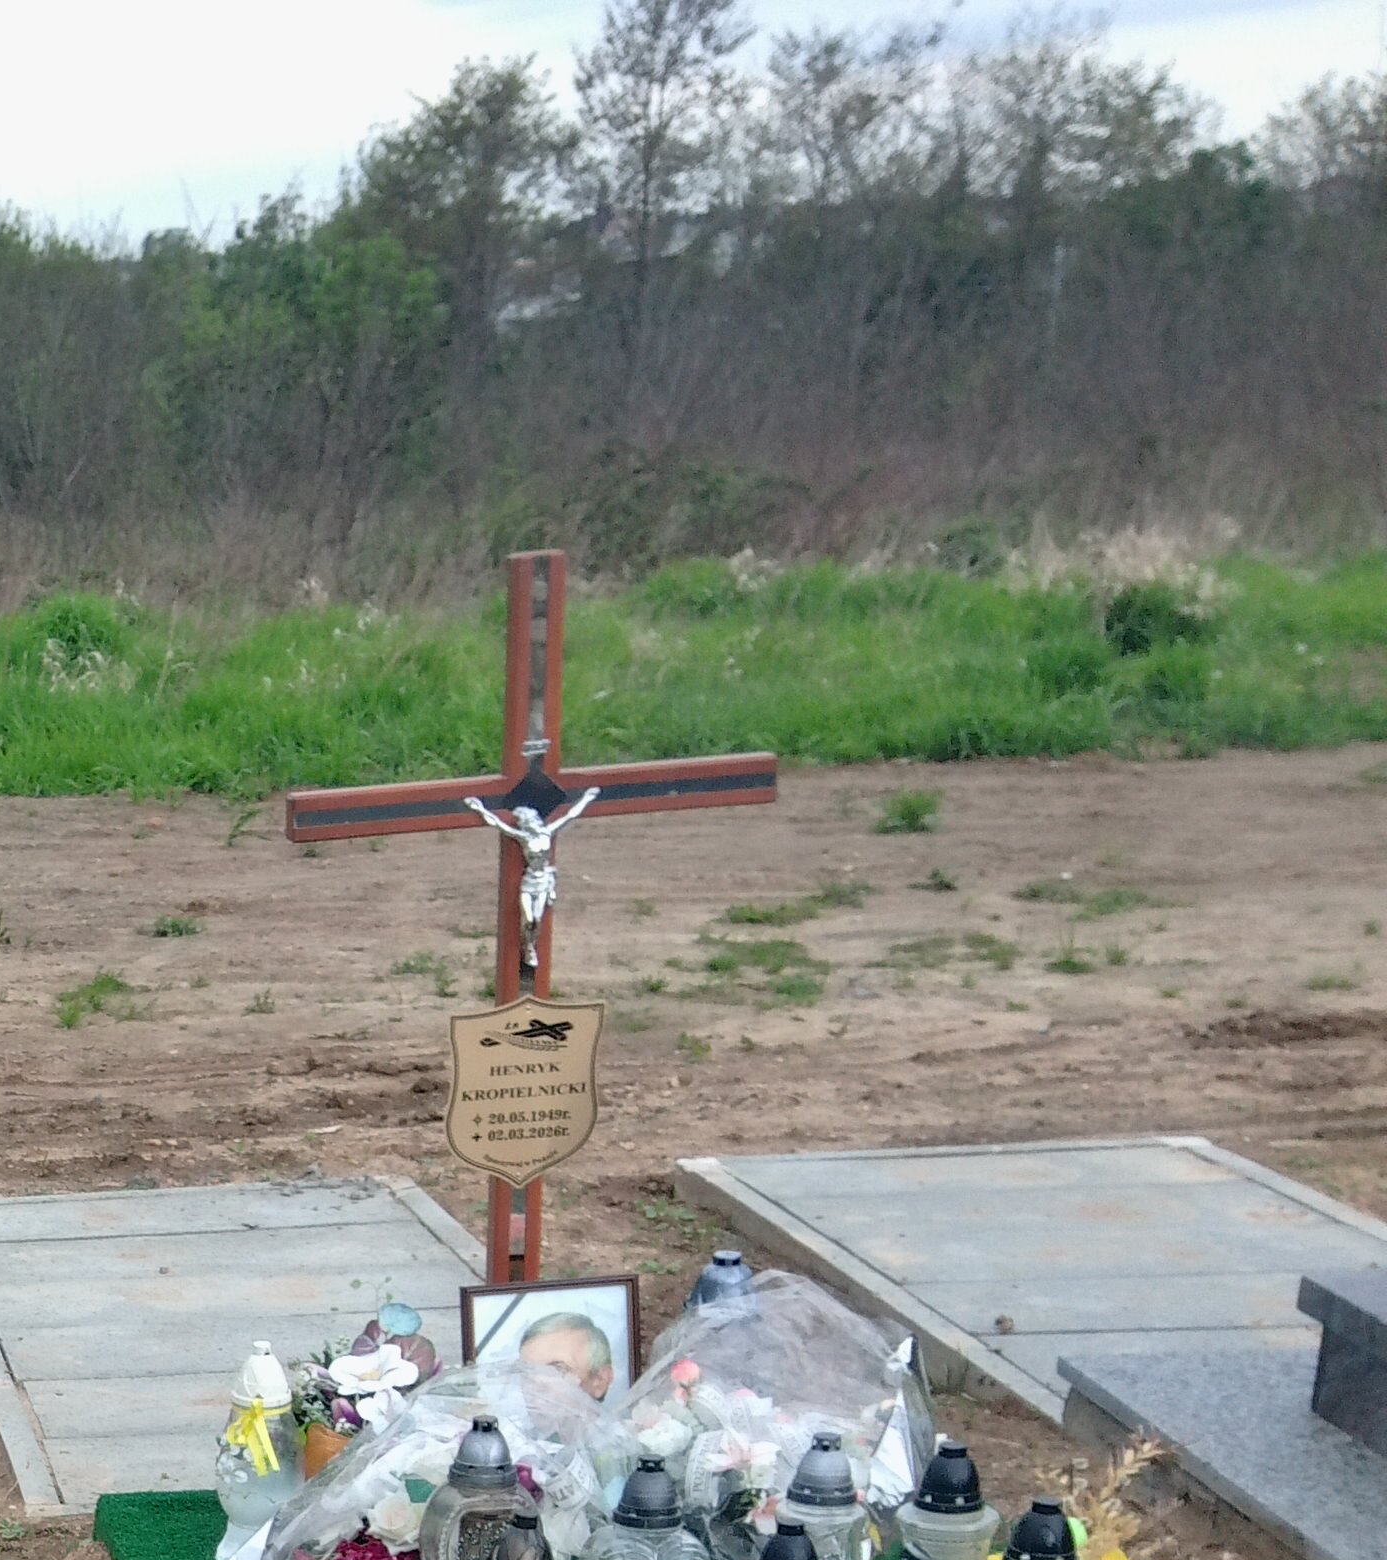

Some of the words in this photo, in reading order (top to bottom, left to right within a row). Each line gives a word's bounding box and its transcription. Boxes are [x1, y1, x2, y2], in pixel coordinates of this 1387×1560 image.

[490, 1061, 560, 1077] HENRYK
[461, 1082, 587, 1102] KROPIELNICKI
[488, 1109, 572, 1125] 20.05.1949r.
[487, 1126, 570, 1142] 02.03.2026r.
